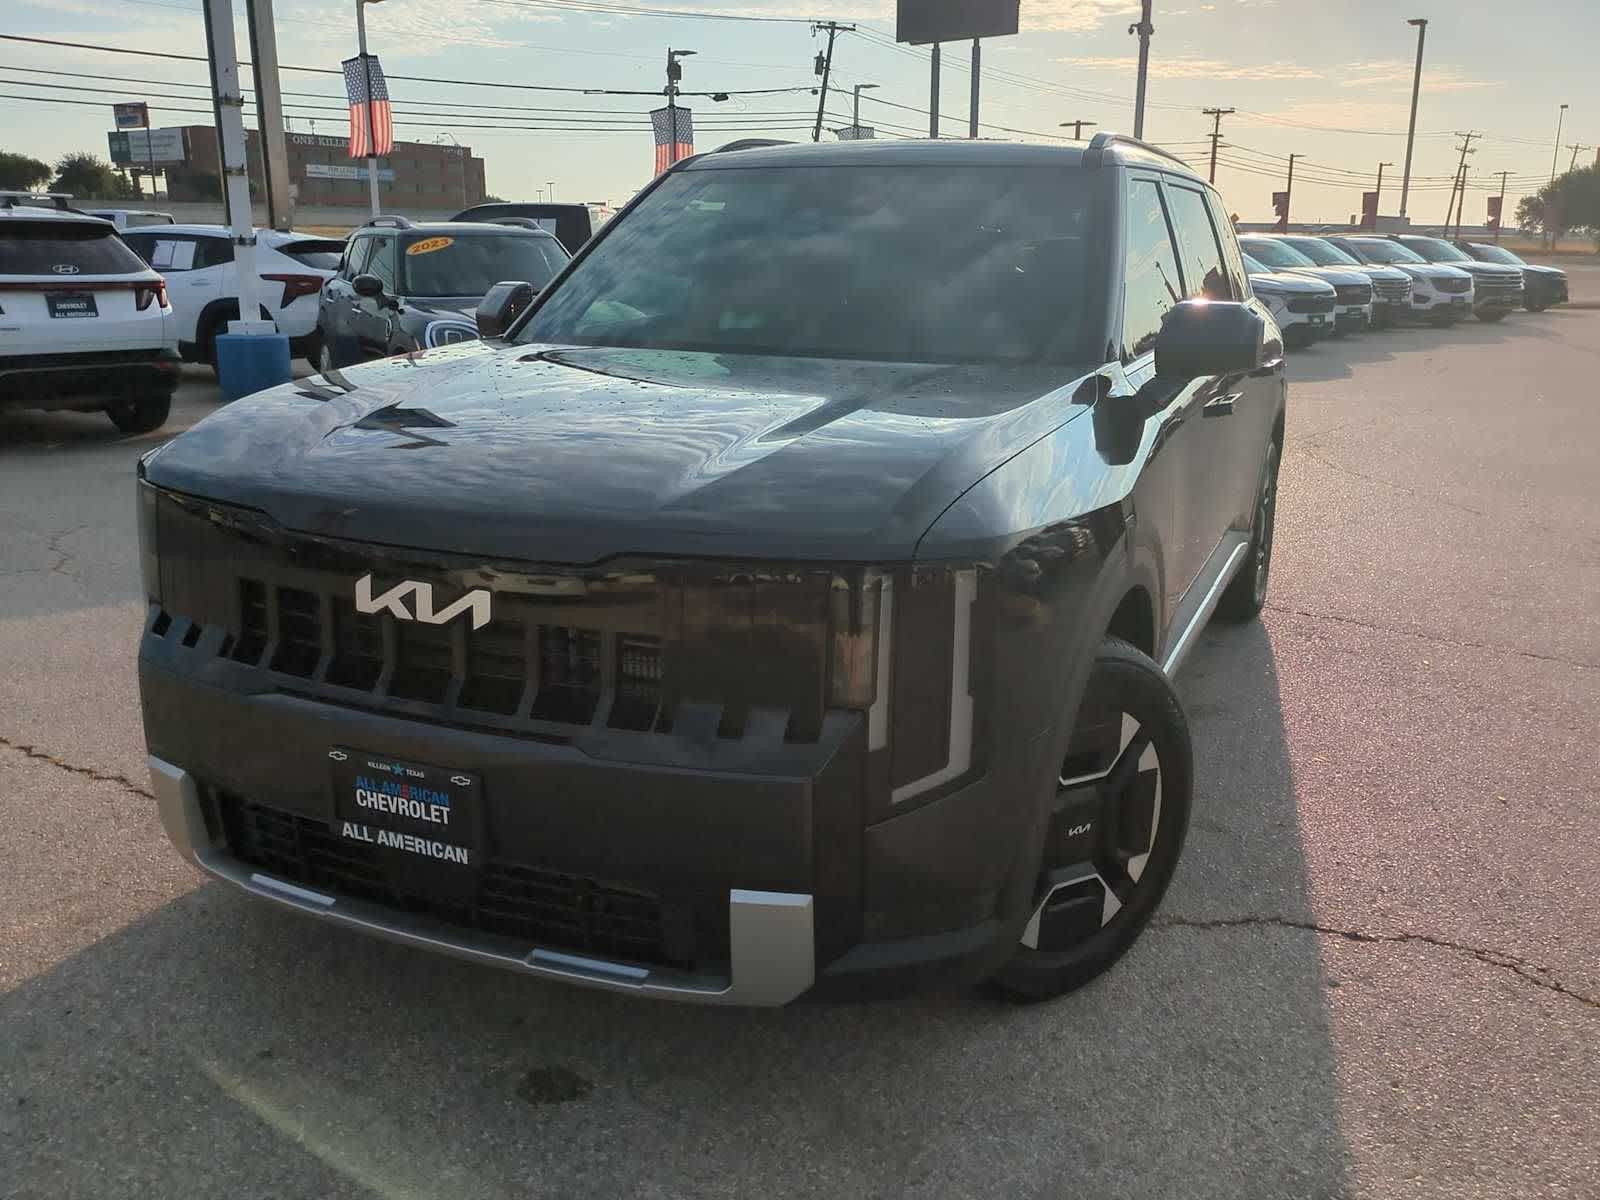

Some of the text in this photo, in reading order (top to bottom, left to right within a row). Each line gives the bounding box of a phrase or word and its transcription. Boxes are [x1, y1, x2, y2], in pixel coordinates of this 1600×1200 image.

[292, 134, 314, 145] ONE
[411, 239, 449, 253] 2023
[355, 573, 491, 630] KIA
[406, 768, 425, 778] TEXAS
[356, 776, 448, 806] ALL AMERICAN
[356, 788, 450, 824] CHEVROLET
[342, 821, 469, 864] ALL AMERICAN
